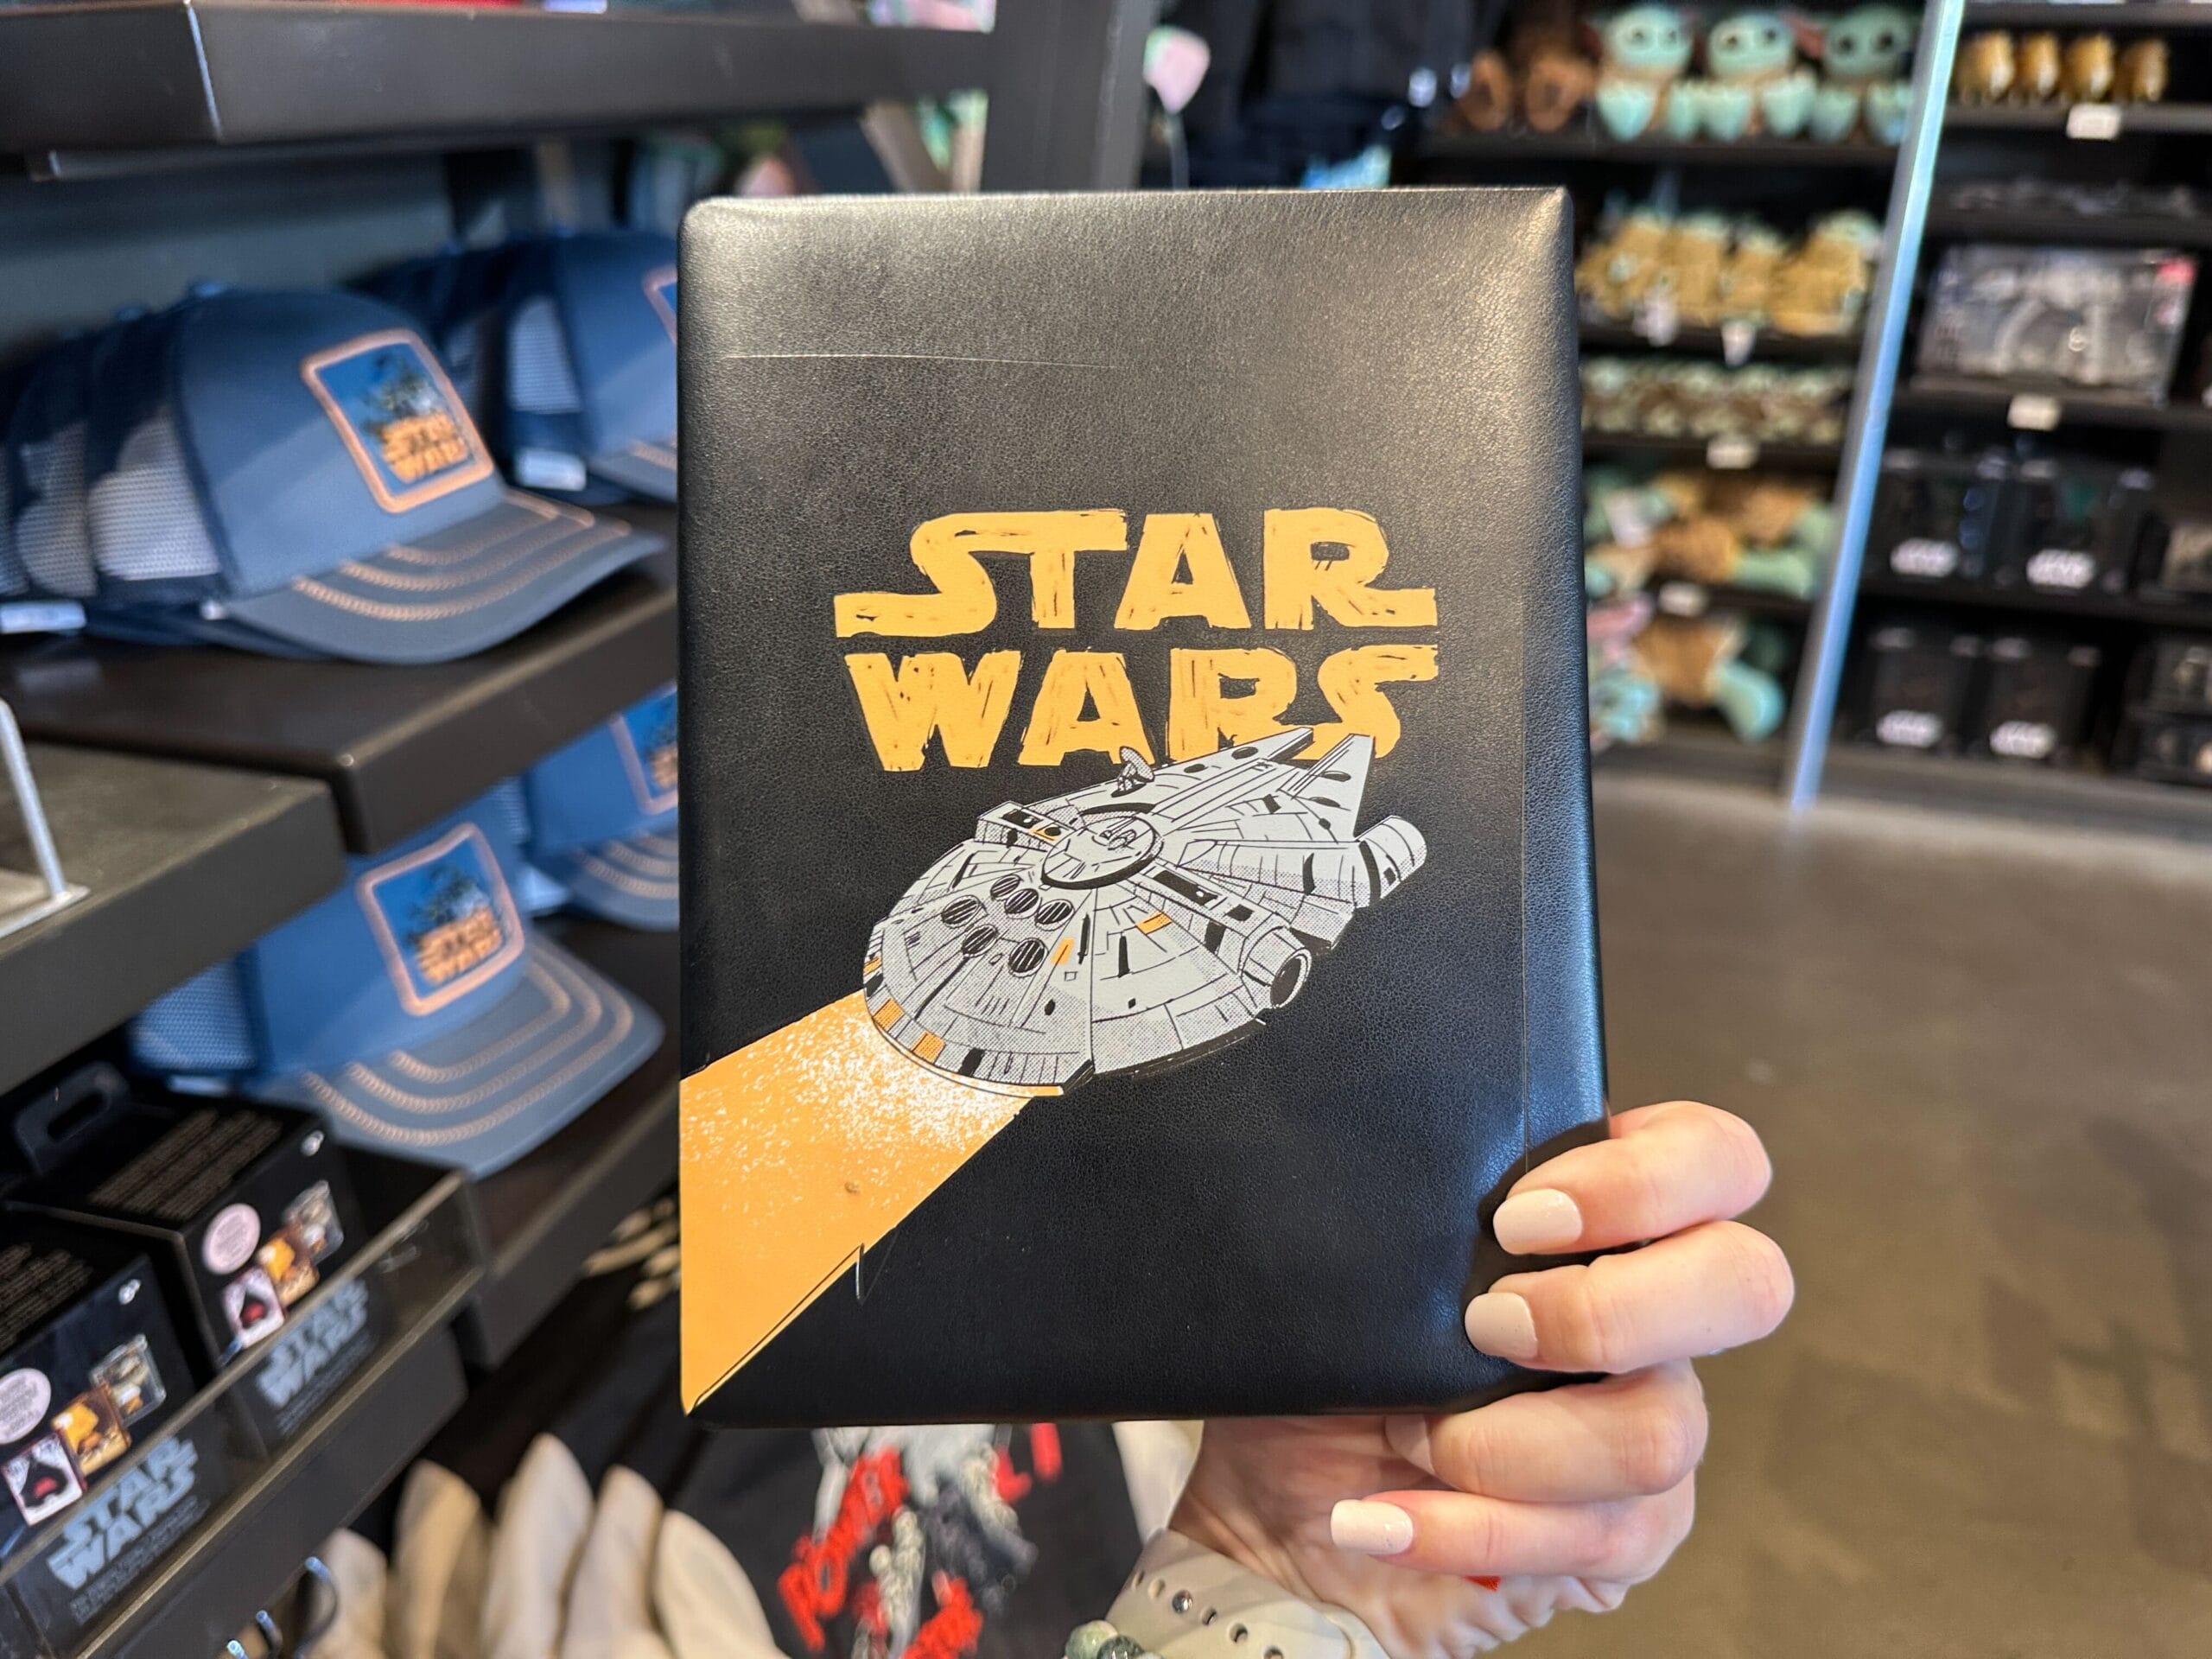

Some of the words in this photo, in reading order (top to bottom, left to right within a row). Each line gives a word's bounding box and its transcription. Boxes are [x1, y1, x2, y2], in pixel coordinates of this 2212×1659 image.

[835, 508, 1437, 638] STAR
[843, 645, 1439, 772] WARS
[52, 1469, 195, 1590] WARS
